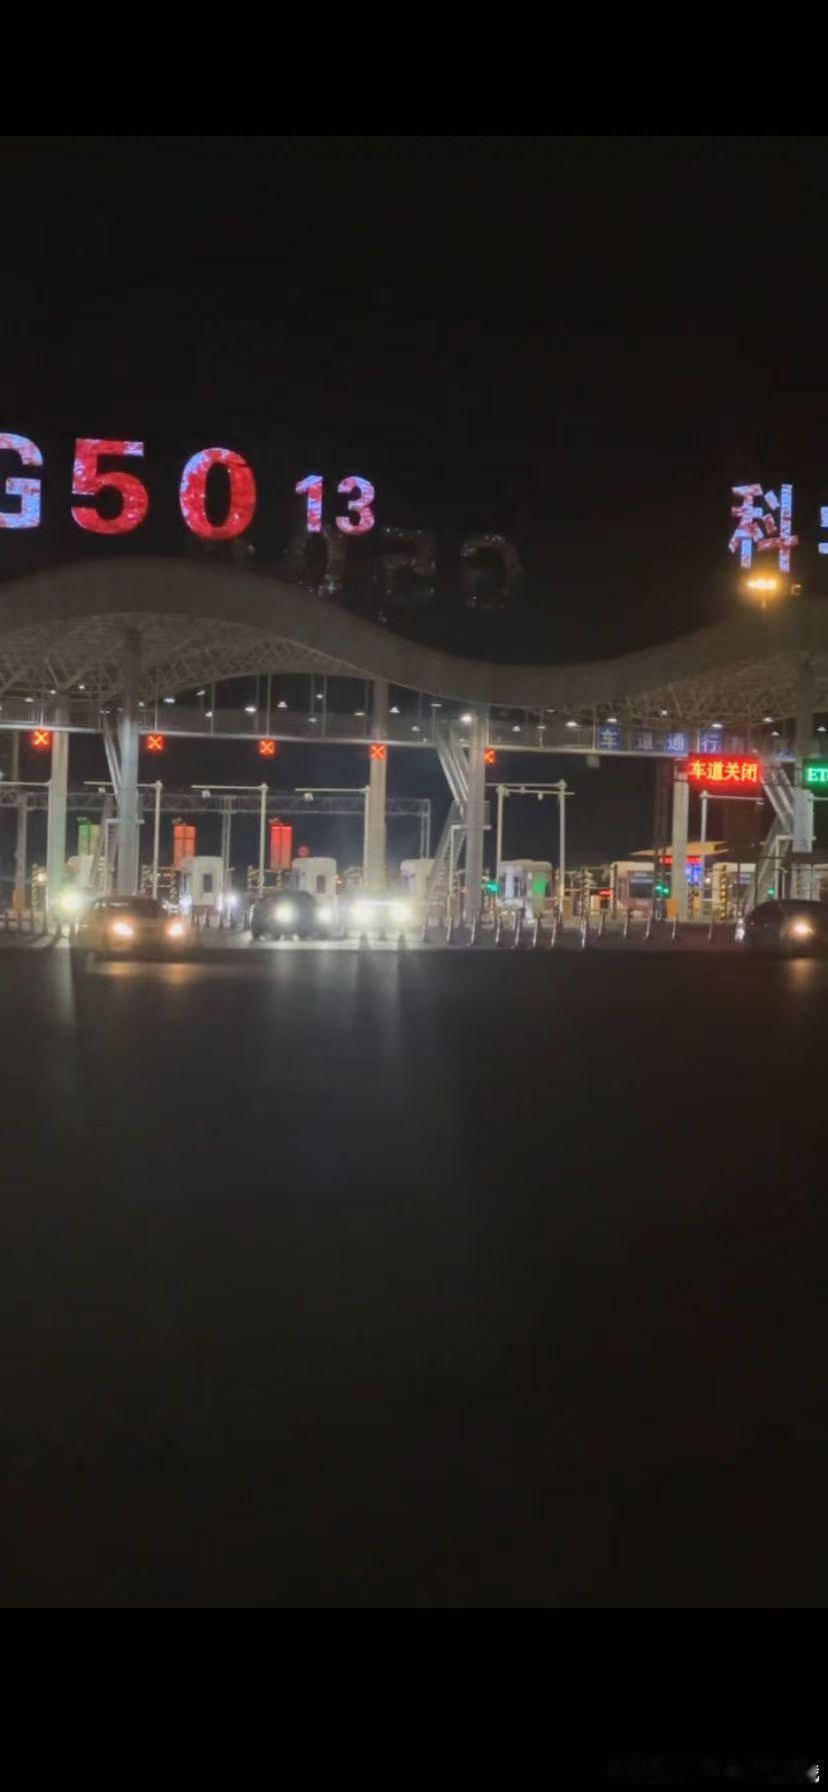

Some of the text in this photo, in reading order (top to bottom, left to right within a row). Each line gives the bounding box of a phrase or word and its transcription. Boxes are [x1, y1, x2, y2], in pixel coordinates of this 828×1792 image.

[728, 483, 828, 572] 科
[689, 760, 758, 782] 车道关闭
[807, 767, 828, 782] ET
